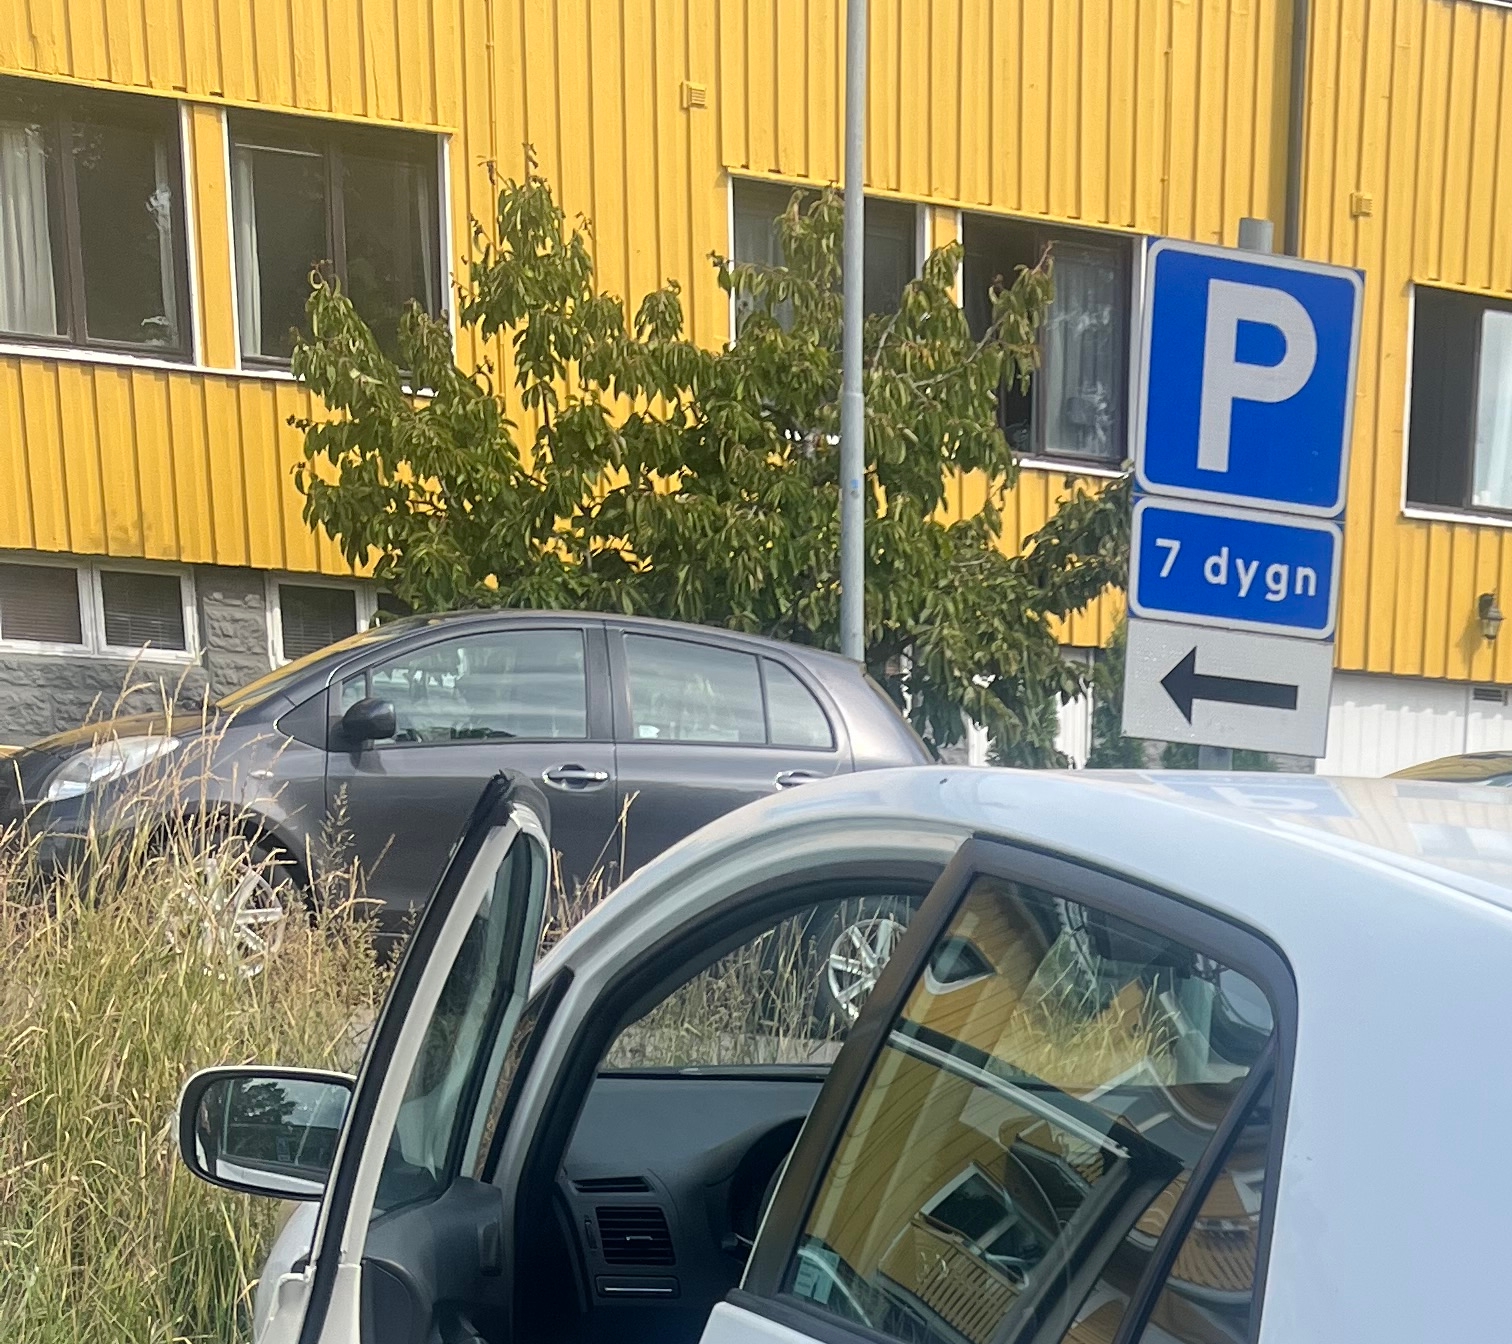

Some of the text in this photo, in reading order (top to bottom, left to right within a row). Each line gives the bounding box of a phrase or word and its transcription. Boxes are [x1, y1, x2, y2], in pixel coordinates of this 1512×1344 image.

[1197, 278, 1317, 473] P
[1154, 538, 1318, 602] 7 dygn
